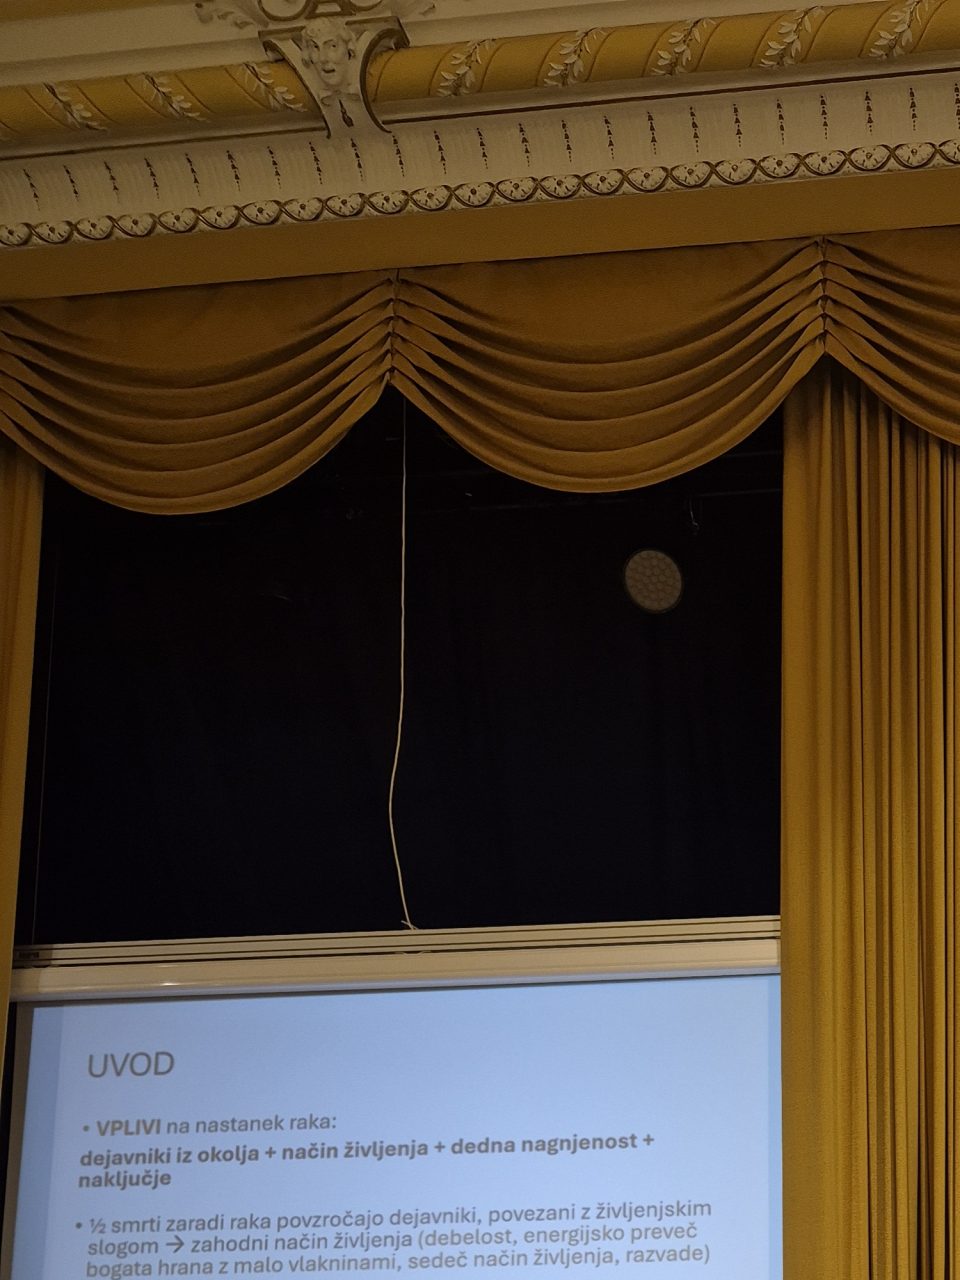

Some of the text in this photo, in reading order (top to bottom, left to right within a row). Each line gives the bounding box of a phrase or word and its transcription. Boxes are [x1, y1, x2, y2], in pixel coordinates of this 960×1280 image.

[88, 1051, 175, 1078] UVOD
[96, 1113, 337, 1137] VPLIVI na nastanek raka:
[80, 1147, 171, 1171] dejavniki
[176, 1147, 192, 1165] iz
[197, 1146, 260, 1167] okolja
[282, 1143, 338, 1162] način
[343, 1139, 428, 1162] življenja
[451, 1136, 516, 1154] dedna
[521, 1133, 637, 1156] nagnjenost
[79, 1169, 171, 1190] naključje
[111, 1216, 160, 1234] smrti
[166, 1214, 224, 1232] zaradi
[230, 1213, 271, 1230] raka
[277, 1210, 383, 1234] povzročajo
[389, 1206, 482, 1229] dejavniki,
[488, 1203, 575, 1226] povezani
[581, 1208, 590, 1220] z
[596, 1200, 712, 1223] življenjskim
[88, 1222, 697, 1259] slogom zahodni način življenja (debelost, energijsko preveč
[86, 1244, 710, 1280] bogata hrana z malo vlakninami, sedeč način življenja, razvade)
